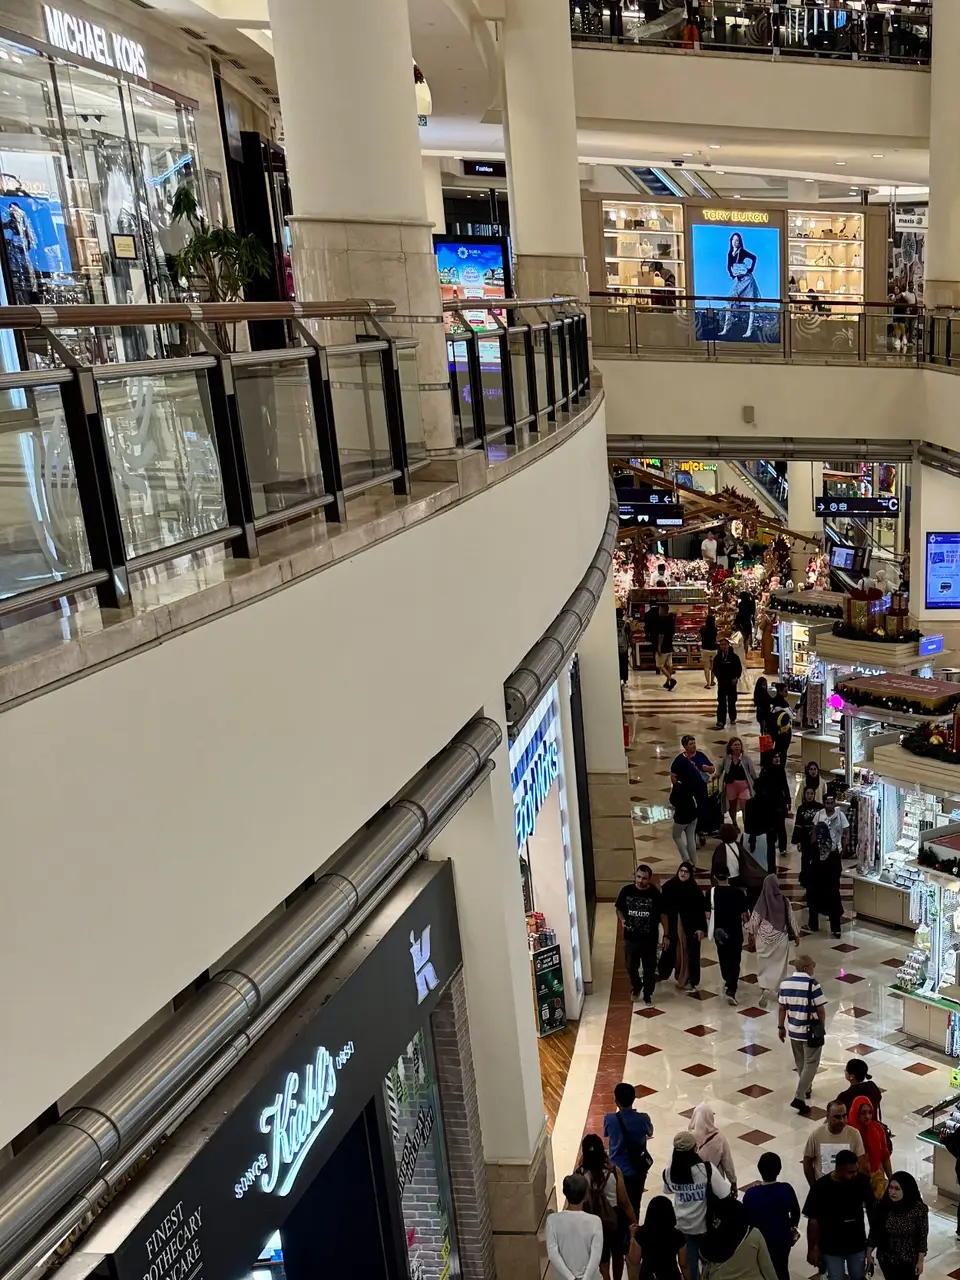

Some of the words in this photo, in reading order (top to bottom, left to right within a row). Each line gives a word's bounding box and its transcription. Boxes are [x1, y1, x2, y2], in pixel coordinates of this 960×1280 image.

[44, 4, 114, 67] MICHAEL
[112, 32, 148, 80] KORS
[702, 209, 730, 221] TORY
[731, 211, 769, 223] BURCH
[898, 217, 915, 225] maxis
[681, 461, 704, 475] JUICE
[889, 498, 898, 510] C
[234, 1153, 268, 1199] SINCE
[259, 1046, 337, 1194] Kiehl's
[145, 1201, 183, 1260] FINEST
